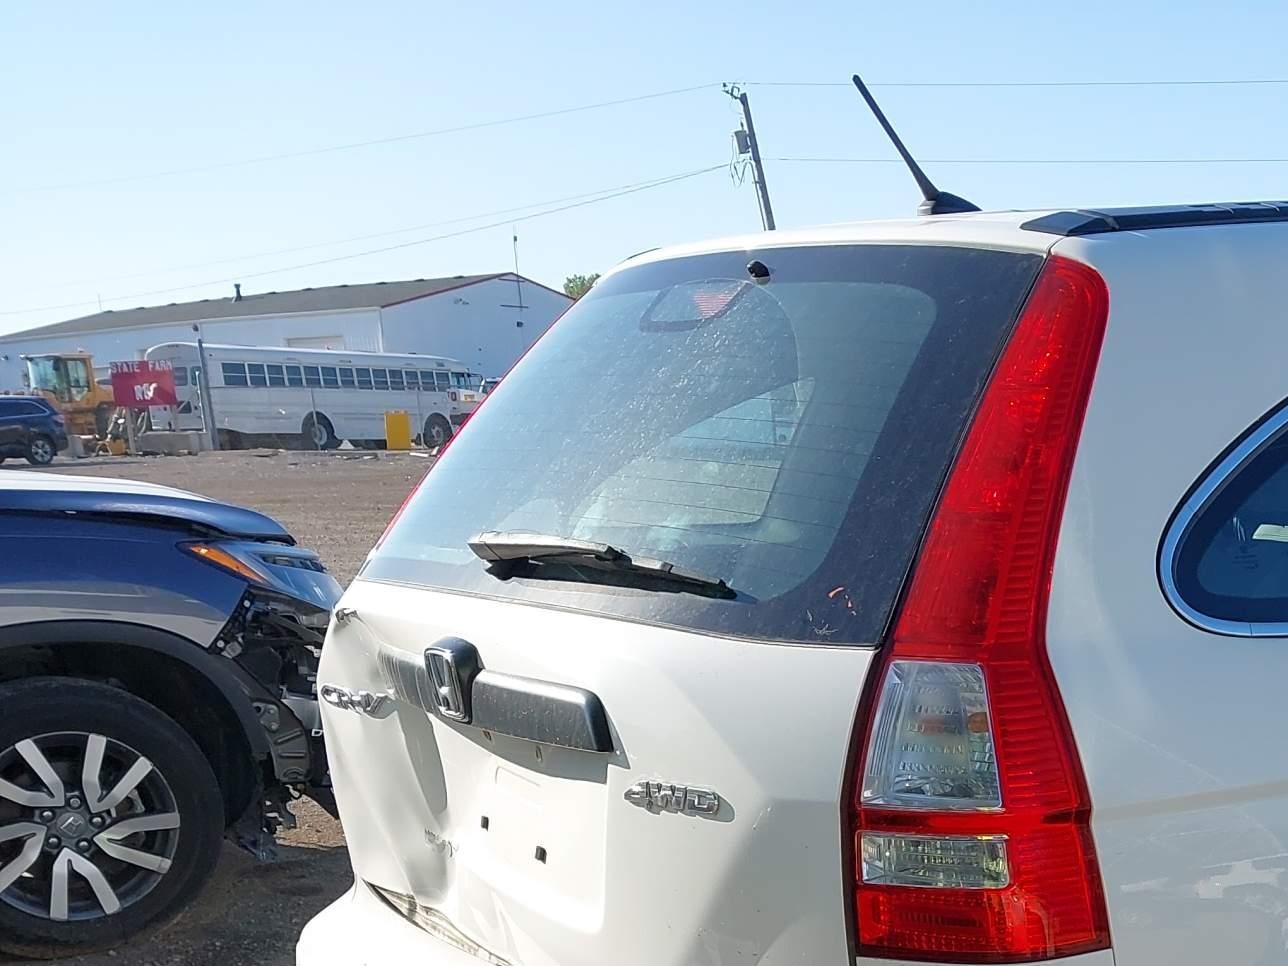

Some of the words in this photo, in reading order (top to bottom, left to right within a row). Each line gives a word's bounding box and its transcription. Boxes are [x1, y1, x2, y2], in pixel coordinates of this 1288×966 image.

[111, 361, 141, 373] STATE
[148, 360, 173, 371] FARM
[624, 781, 720, 816] 4WD
